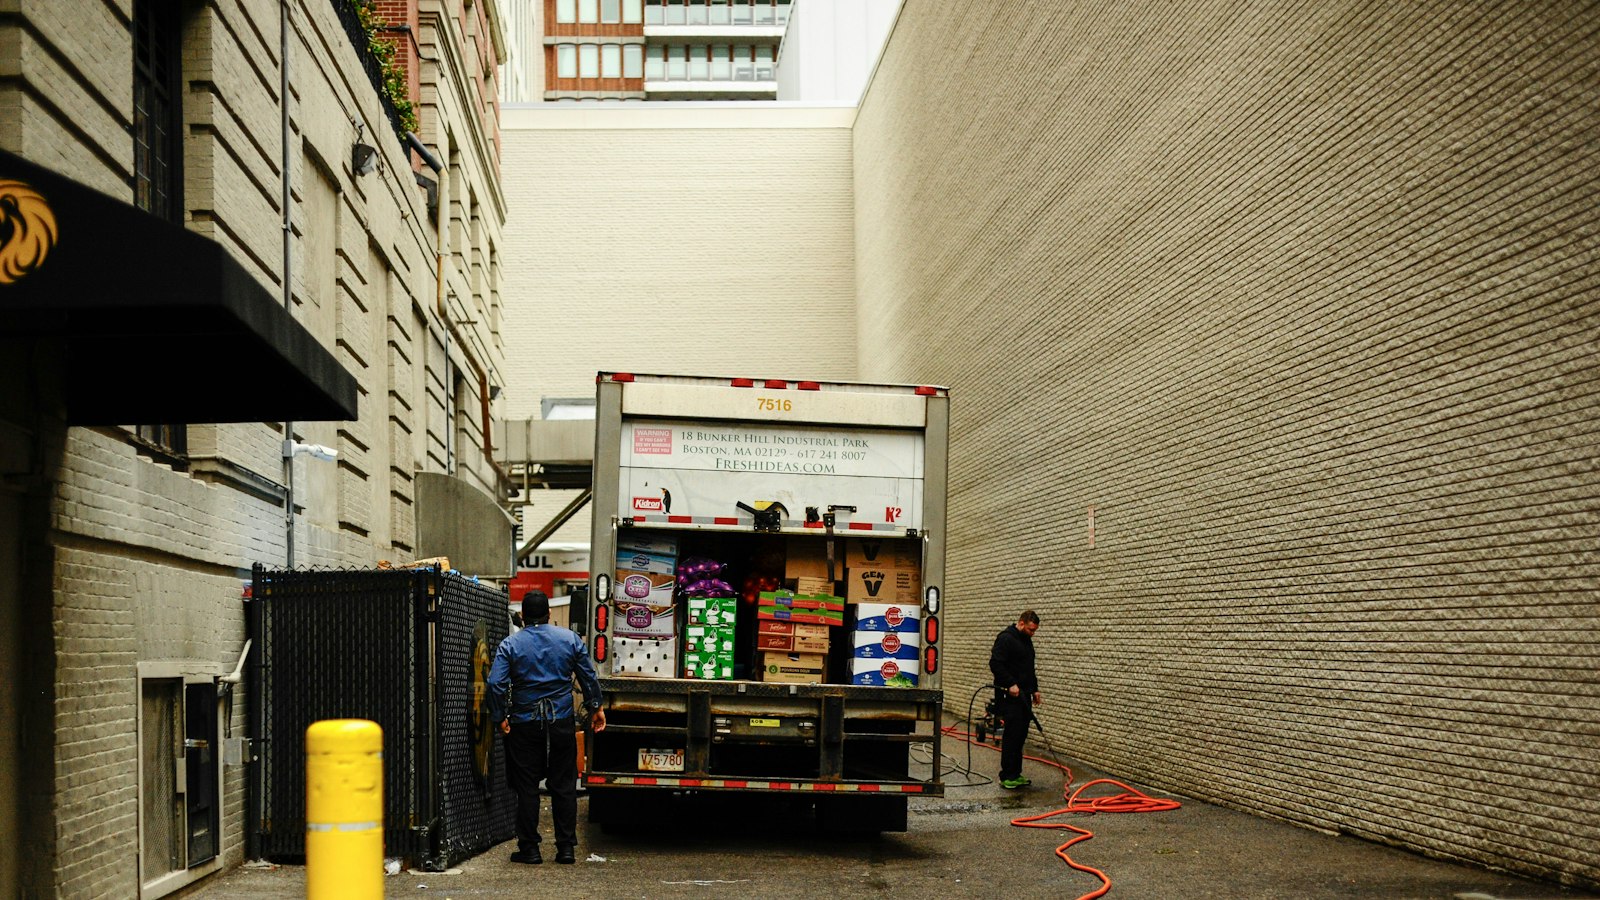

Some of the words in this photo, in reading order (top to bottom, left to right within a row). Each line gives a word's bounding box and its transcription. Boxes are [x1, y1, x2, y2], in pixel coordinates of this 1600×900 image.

[757, 398, 792, 411] 7516
[682, 431, 692, 440] 18
[697, 432, 741, 442] BUNKER
[744, 434, 770, 444] HILL
[773, 435, 838, 446] INDUSTRIAL
[842, 438, 869, 448] PARK
[683, 444, 730, 456] BOSTON,
[734, 447, 753, 456] MA
[755, 448, 787, 457] 02129
[798, 449, 816, 459] 617
[819, 450, 837, 459] 241
[841, 451, 866, 460] 8007
[716, 458, 835, 474] FRESHIDEAS.COM
[635, 500, 660, 508] Kidron
[862, 571, 885, 579] GEN
[864, 580, 882, 596] V
